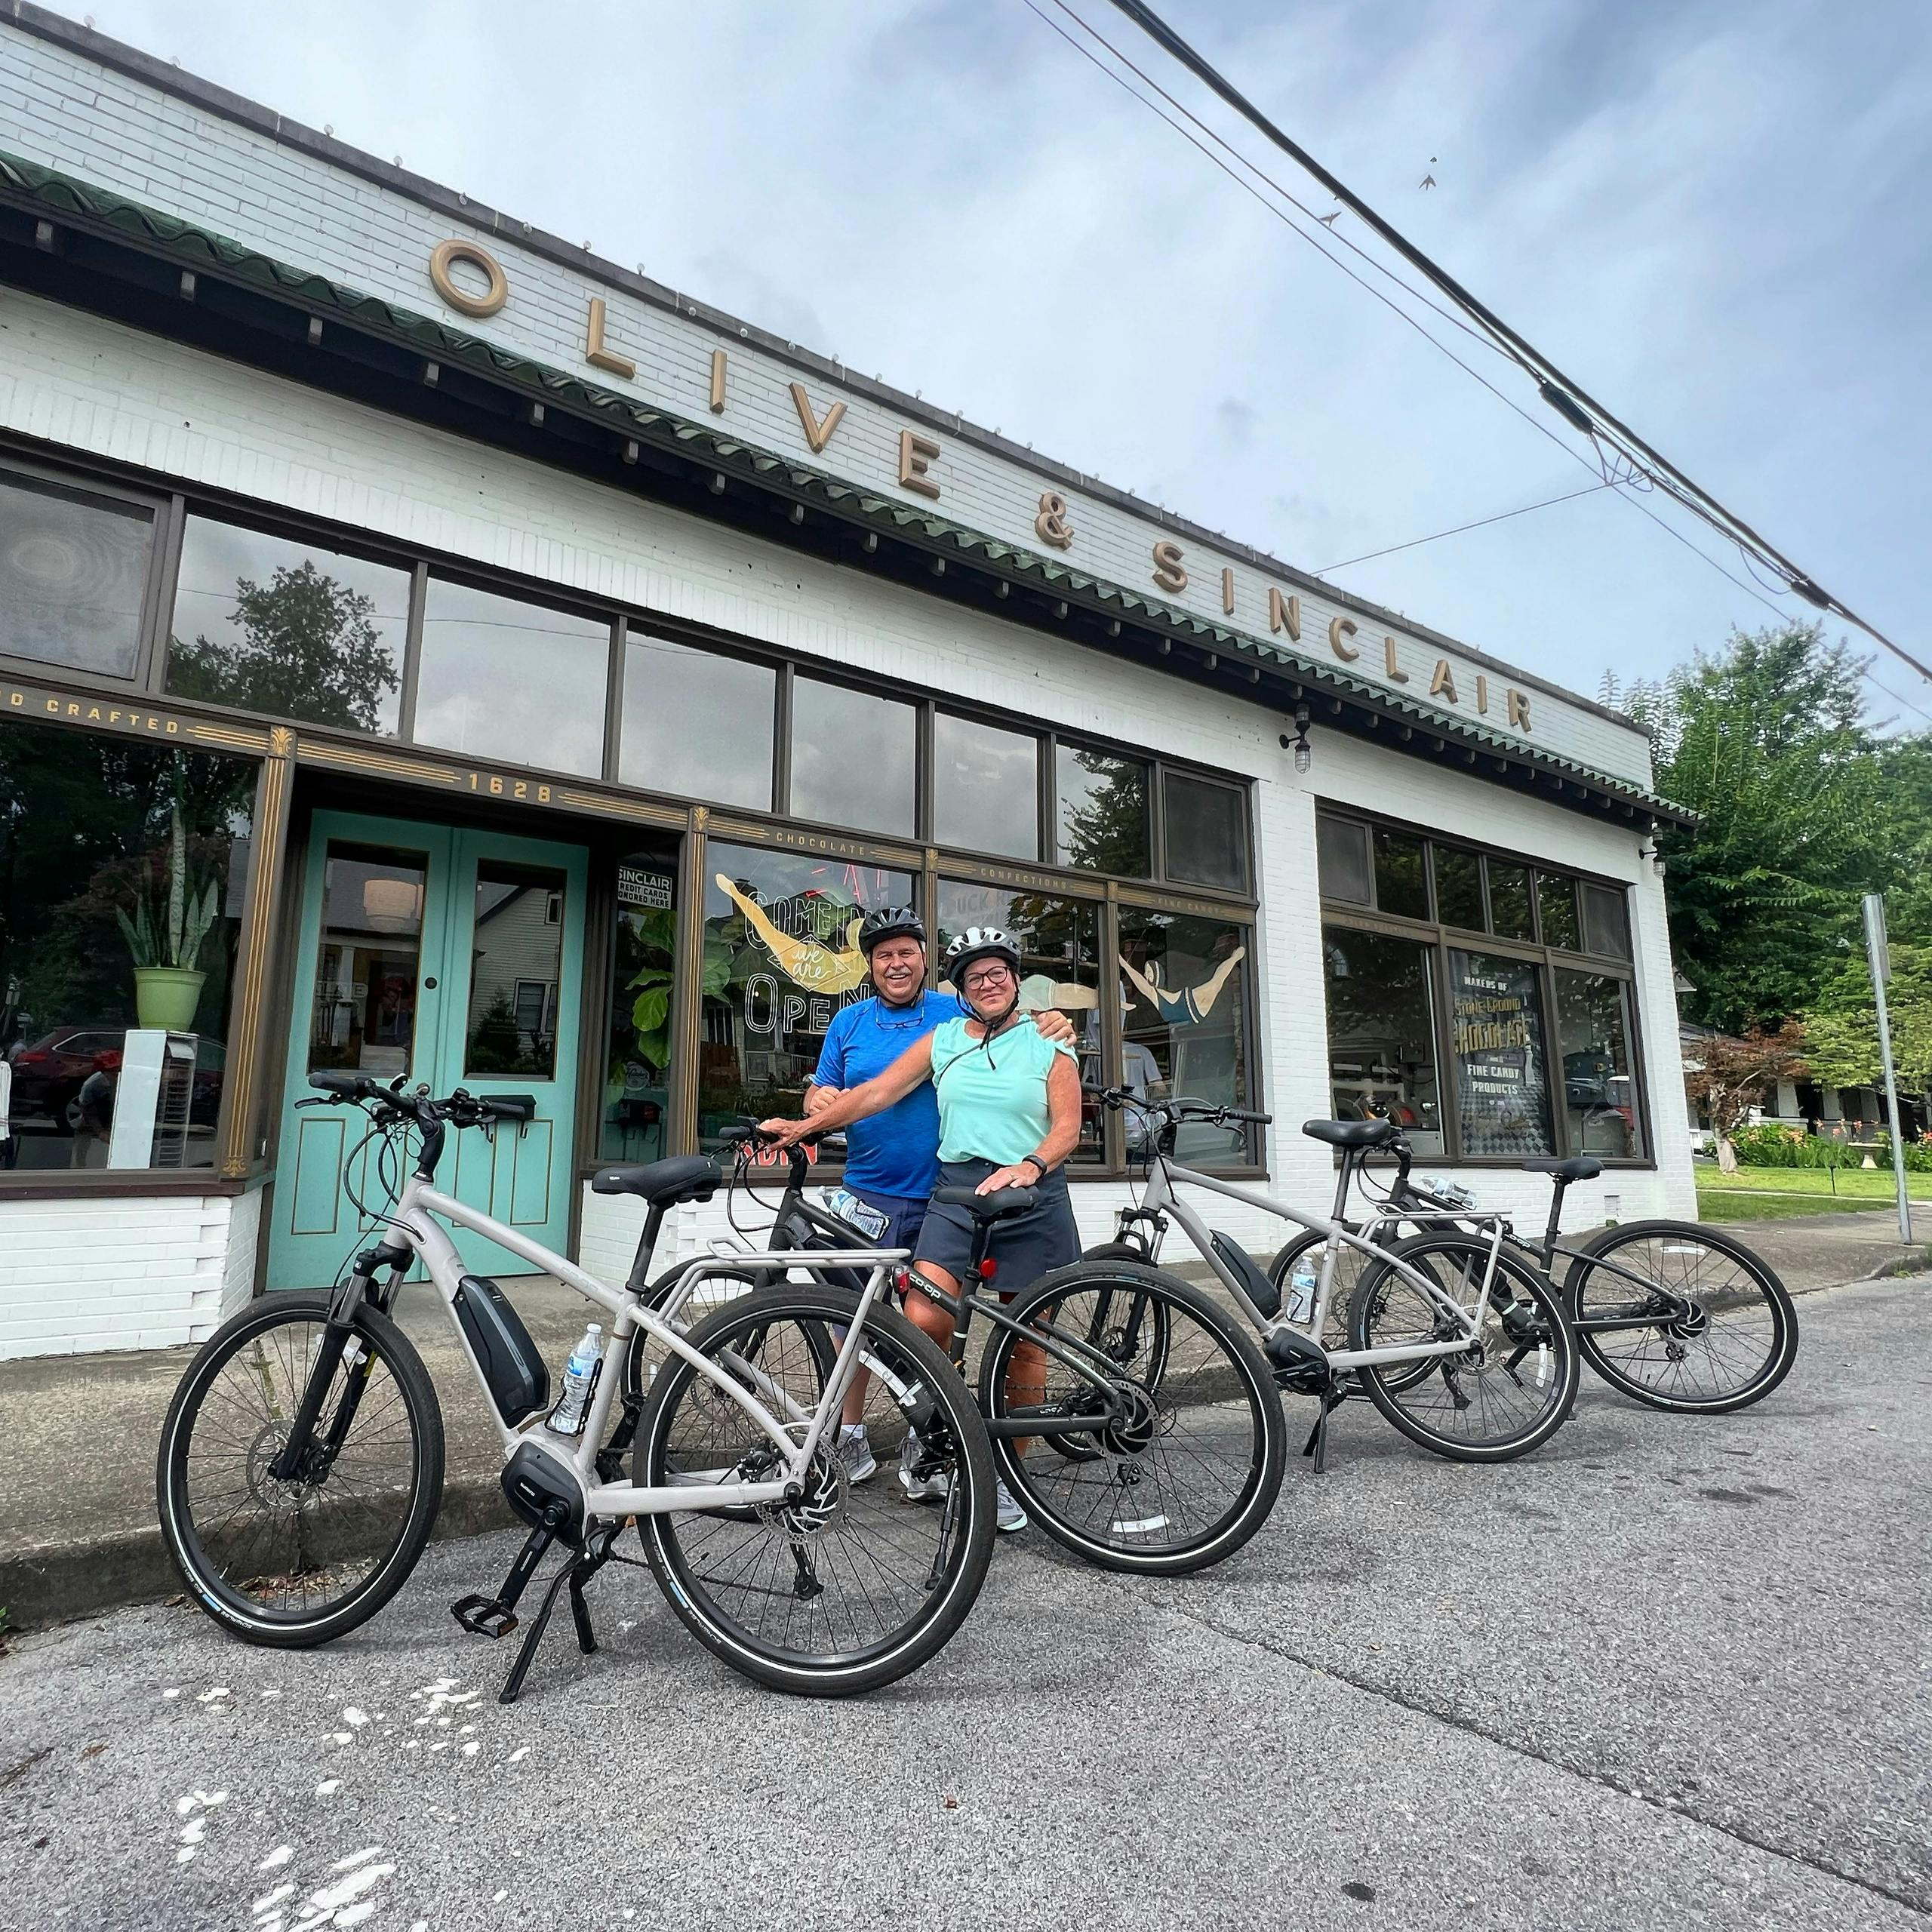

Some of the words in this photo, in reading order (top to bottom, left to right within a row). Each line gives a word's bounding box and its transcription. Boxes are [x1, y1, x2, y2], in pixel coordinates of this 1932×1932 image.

[429, 238, 940, 500] OLIVE
[1035, 491, 1074, 550] &
[1152, 540, 1533, 732] SINCLAIR
[46, 699, 178, 734] CRAFTED
[469, 774, 551, 803] 1628
[777, 832, 865, 856] CHOCOLATE
[619, 868, 670, 890] SINCLAIR
[980, 868, 1067, 890] CONFECTIONS
[619, 891, 648, 903] ONORED
[651, 899, 669, 908] HERE
[620, 882, 641, 894] REDIT
[643, 888, 668, 900] CARDS
[744, 891, 832, 950] COME
[1464, 976, 1496, 989] MAKERS
[1497, 982, 1508, 992] OF
[1466, 1063, 1489, 1077] FINE
[1491, 1066, 1520, 1079] CANDY
[1472, 1081, 1518, 1095] PRODUCTS
